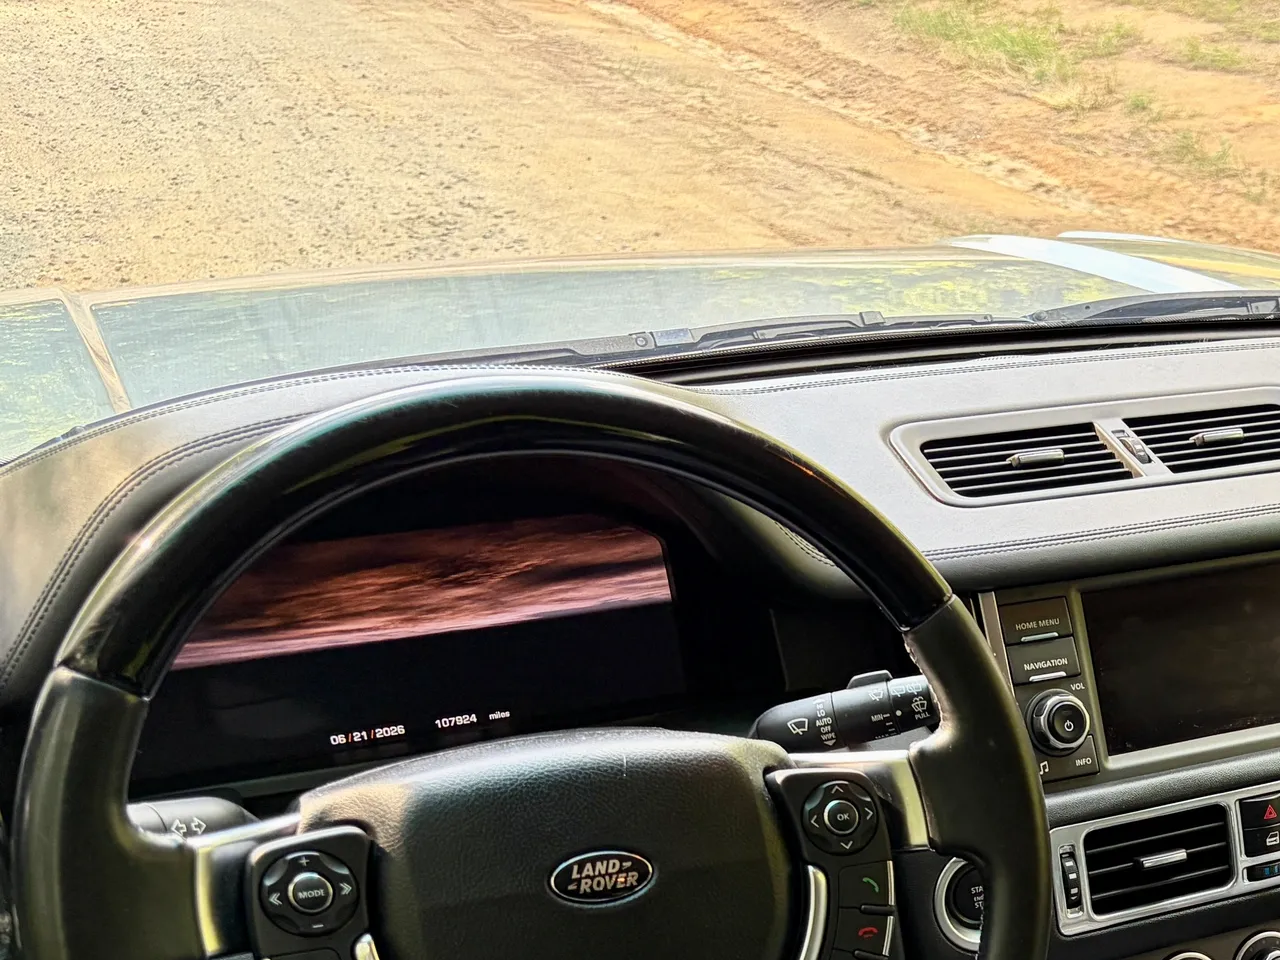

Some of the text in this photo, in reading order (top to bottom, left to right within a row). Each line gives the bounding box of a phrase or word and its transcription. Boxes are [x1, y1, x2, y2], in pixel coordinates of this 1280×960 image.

[1015, 617, 1060, 631] HOME MENU
[1023, 657, 1069, 671] NAVIGATION
[1070, 682, 1086, 691] VOL
[488, 709, 511, 721] miles
[871, 714, 884, 723] MIN
[914, 711, 931, 721] PULL
[815, 716, 832, 727] AUTO
[820, 725, 832, 734] OFF
[820, 732, 837, 742] WIPE
[1075, 757, 1092, 767] INFO
[836, 812, 850, 822] OK
[571, 859, 620, 880] LAND
[579, 871, 639, 895] ROVER
[297, 887, 326, 900] MODE
